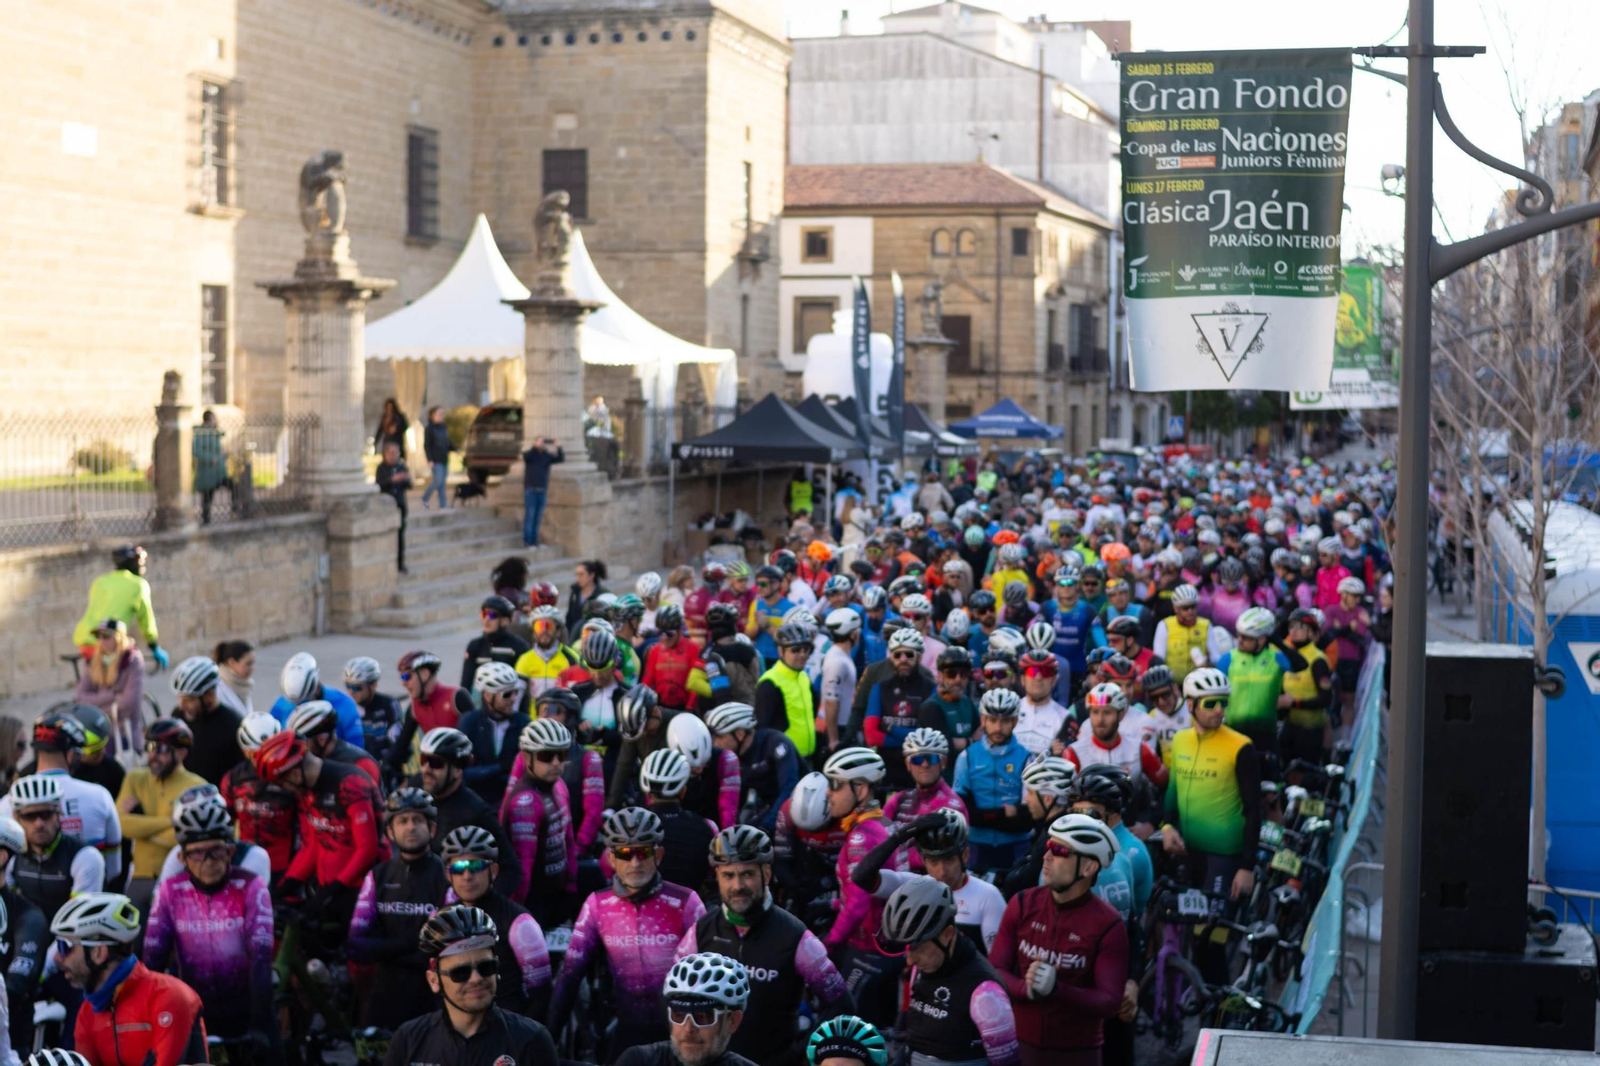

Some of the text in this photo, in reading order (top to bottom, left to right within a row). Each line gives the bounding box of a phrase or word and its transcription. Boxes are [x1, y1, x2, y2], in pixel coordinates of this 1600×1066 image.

[1163, 63, 1173, 75] 15
[1176, 62, 1214, 75] FEBRERO
[1128, 77, 1348, 112] Gran Fondo
[1126, 118, 1220, 132] DOMINGO 16 FEBRERO
[1221, 126, 1346, 152] Naciones
[1127, 139, 1217, 157] Copa de las
[1160, 158, 1180, 168] UCI
[1221, 153, 1282, 170] Juniors
[1126, 180, 1205, 194] LUNES 17 FEBRERO
[1124, 189, 1309, 231] Clásica Jaén
[1209, 230, 1273, 248] PARAÍSO
[692, 447, 734, 457] PISSEI
[377, 901, 440, 916] BIKESHO
[604, 933, 678, 947] BIKESHOP
[923, 1003, 949, 1019] SHOP
